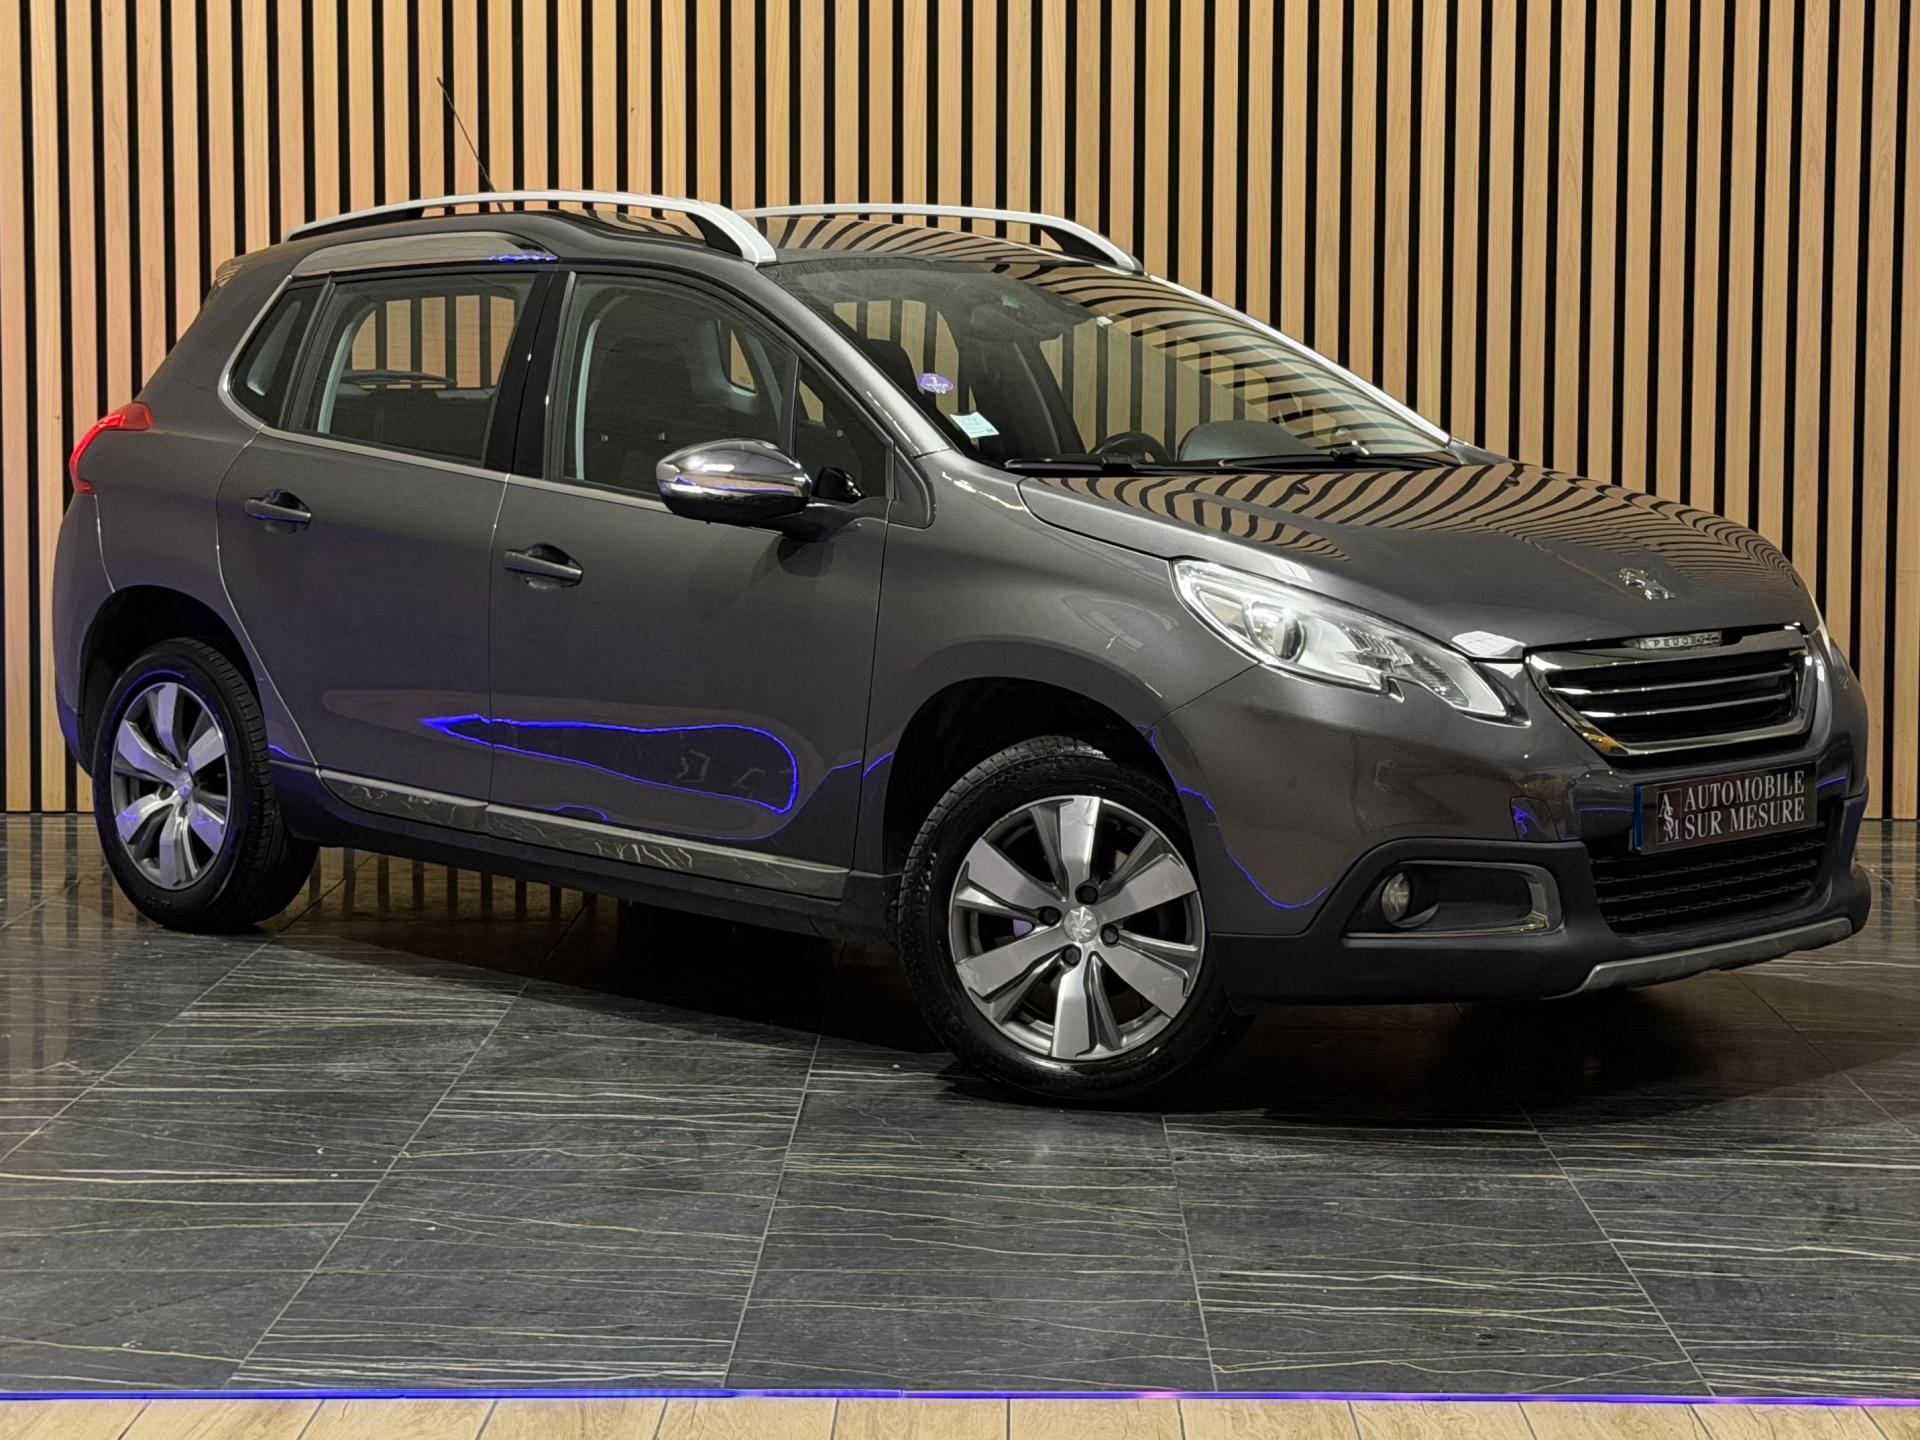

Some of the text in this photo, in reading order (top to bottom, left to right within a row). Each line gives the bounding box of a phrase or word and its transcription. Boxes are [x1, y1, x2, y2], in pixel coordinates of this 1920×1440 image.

[1653, 633, 1715, 647] PEUGEO
[1683, 770, 1805, 812] AUTOMOBILE
[1684, 796, 1805, 841] SUR MESURE
